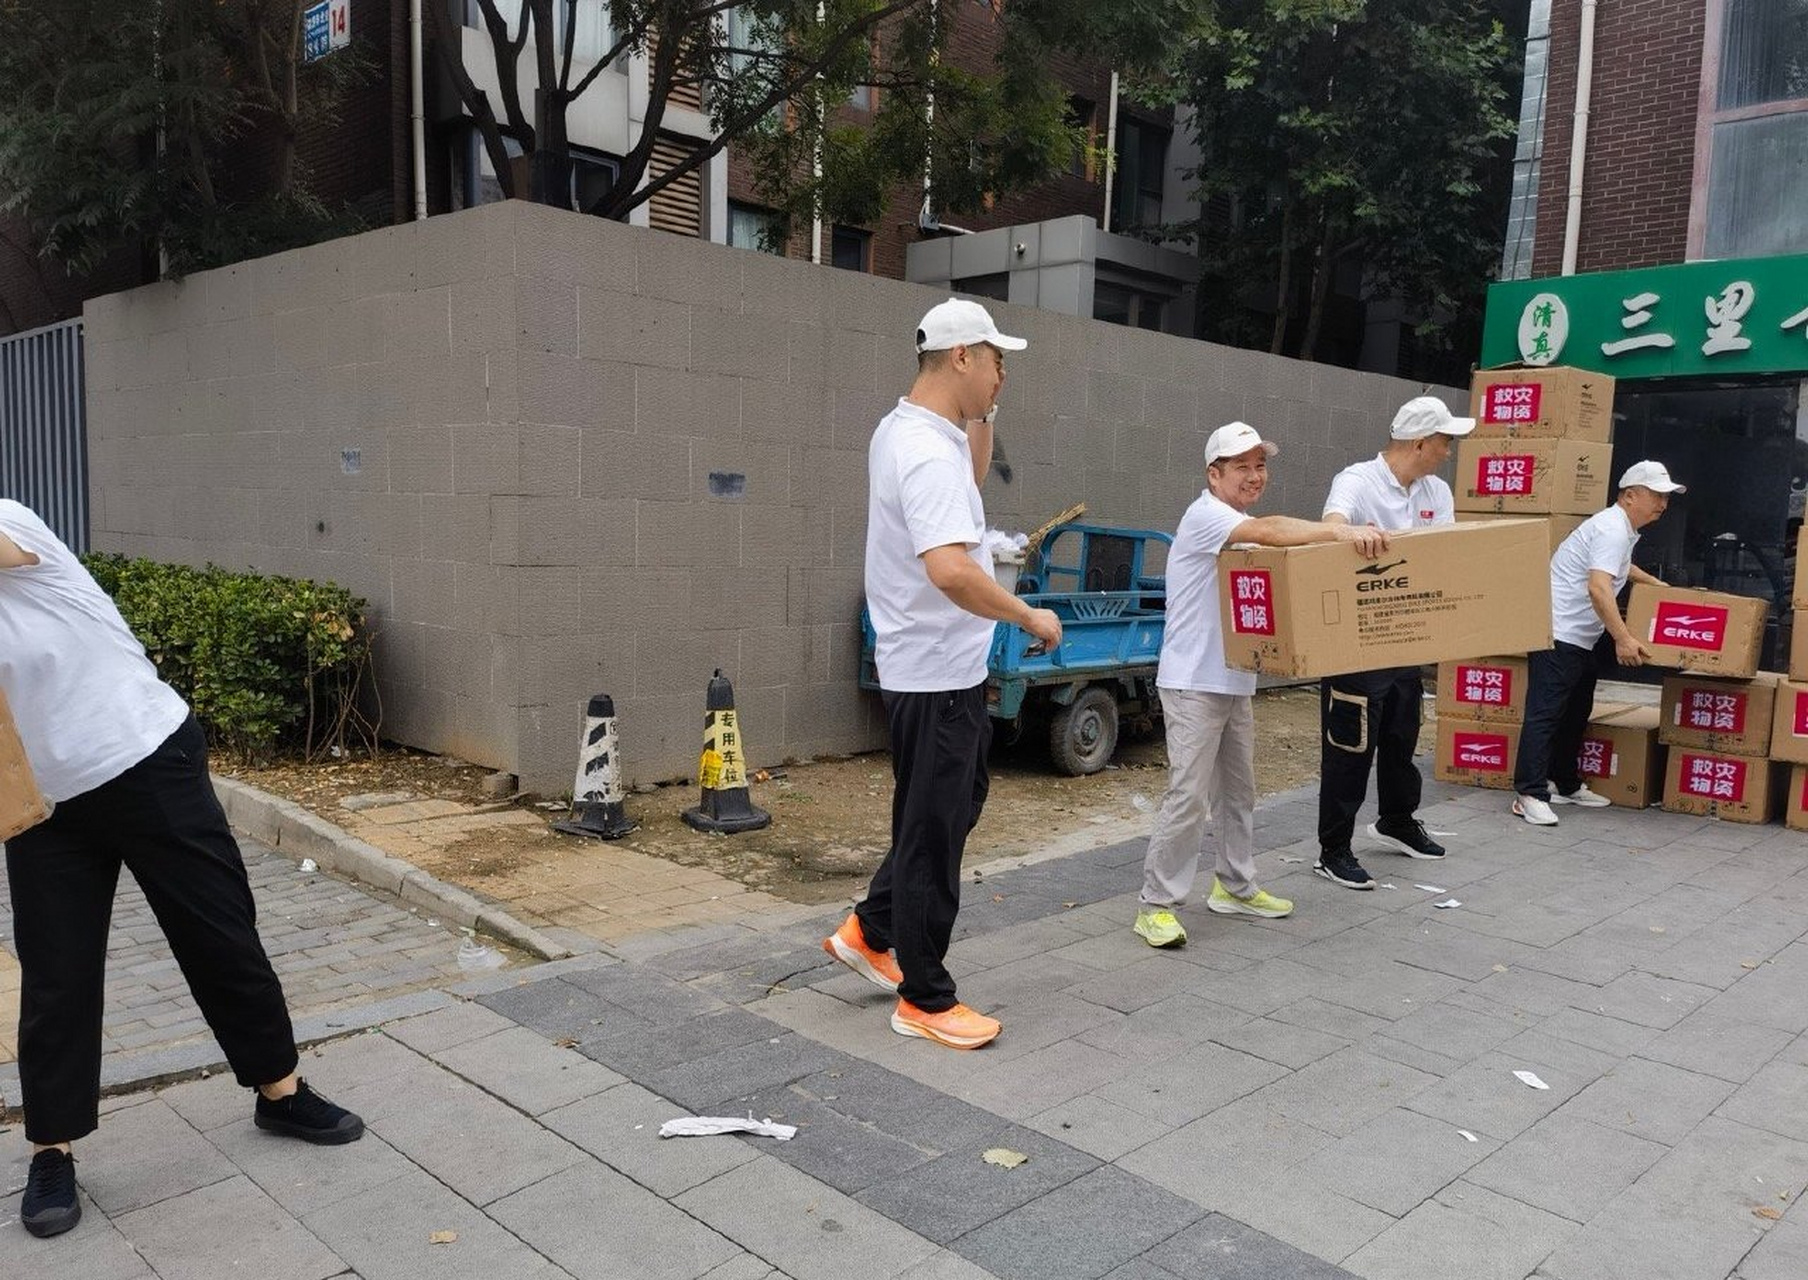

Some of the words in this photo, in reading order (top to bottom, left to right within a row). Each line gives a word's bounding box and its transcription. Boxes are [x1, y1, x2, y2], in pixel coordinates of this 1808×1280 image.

[332, 6, 345, 37] 14
[1601, 280, 1808, 356] 三里
[1529, 302, 1556, 360] 清真
[1494, 388, 1533, 403] 救灾
[1493, 405, 1531, 419] 物资
[1487, 460, 1526, 474] 救灾
[1486, 476, 1523, 491] 物资
[1237, 576, 1265, 600] 救灾
[1356, 577, 1408, 592] ERKE
[1240, 605, 1268, 629] 物资
[1663, 627, 1715, 641] ERKE
[1466, 670, 1503, 686] 救灾
[1465, 686, 1502, 701] 物资
[1693, 693, 1736, 711] 救灾
[1691, 710, 1734, 729] 物资
[721, 713, 739, 783] 专用车位
[1460, 754, 1501, 764] ERKE
[1577, 757, 1602, 773] 资
[1692, 759, 1736, 779] 救灾
[1690, 777, 1734, 797] 物资
